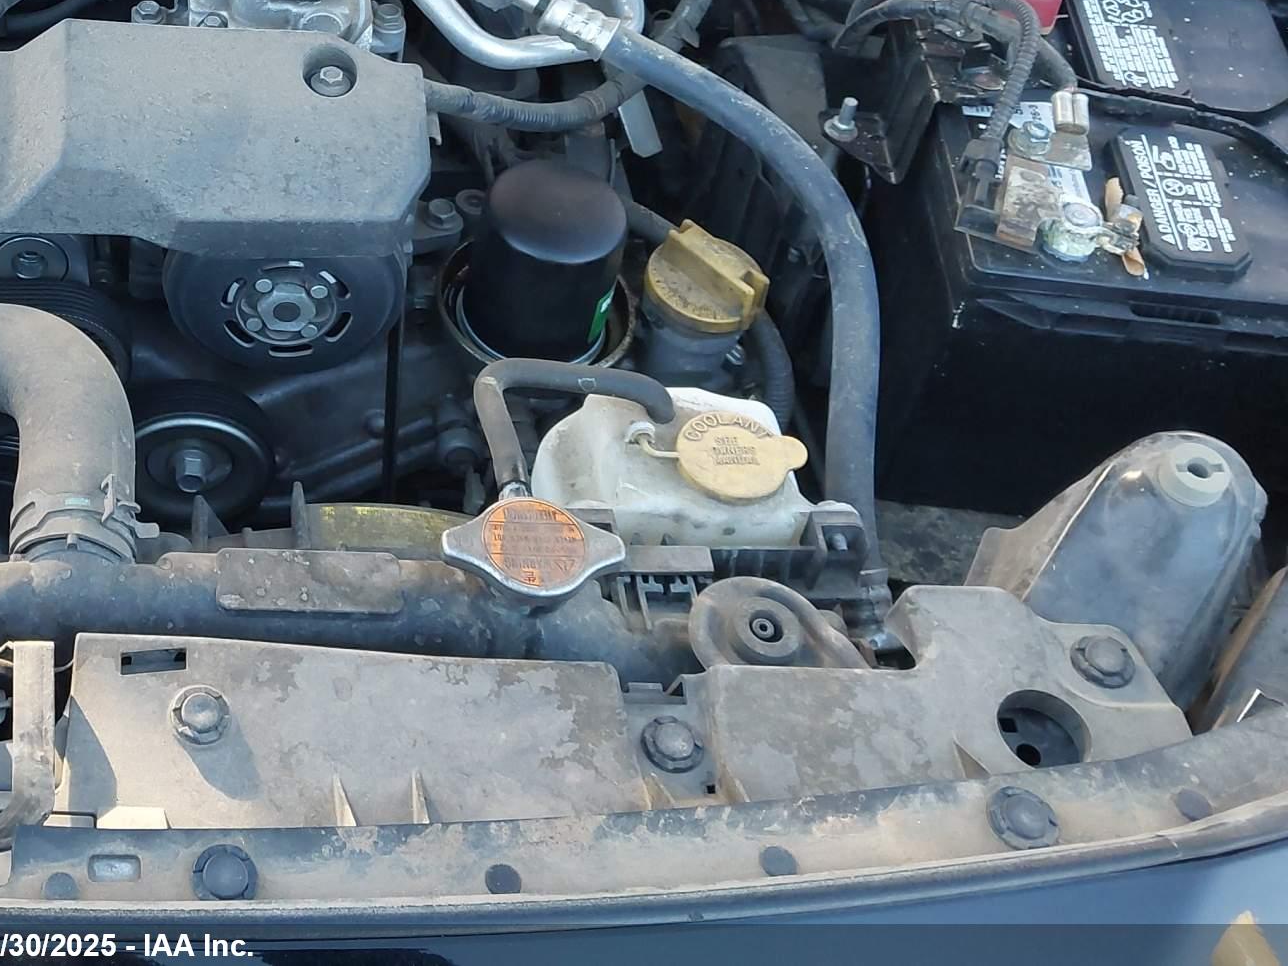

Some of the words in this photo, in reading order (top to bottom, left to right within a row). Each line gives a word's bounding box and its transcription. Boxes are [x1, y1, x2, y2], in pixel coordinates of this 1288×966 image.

[1130, 139, 1156, 180] POISON
[1146, 188, 1173, 234] DANGER
[685, 414, 772, 441] COOLANT
